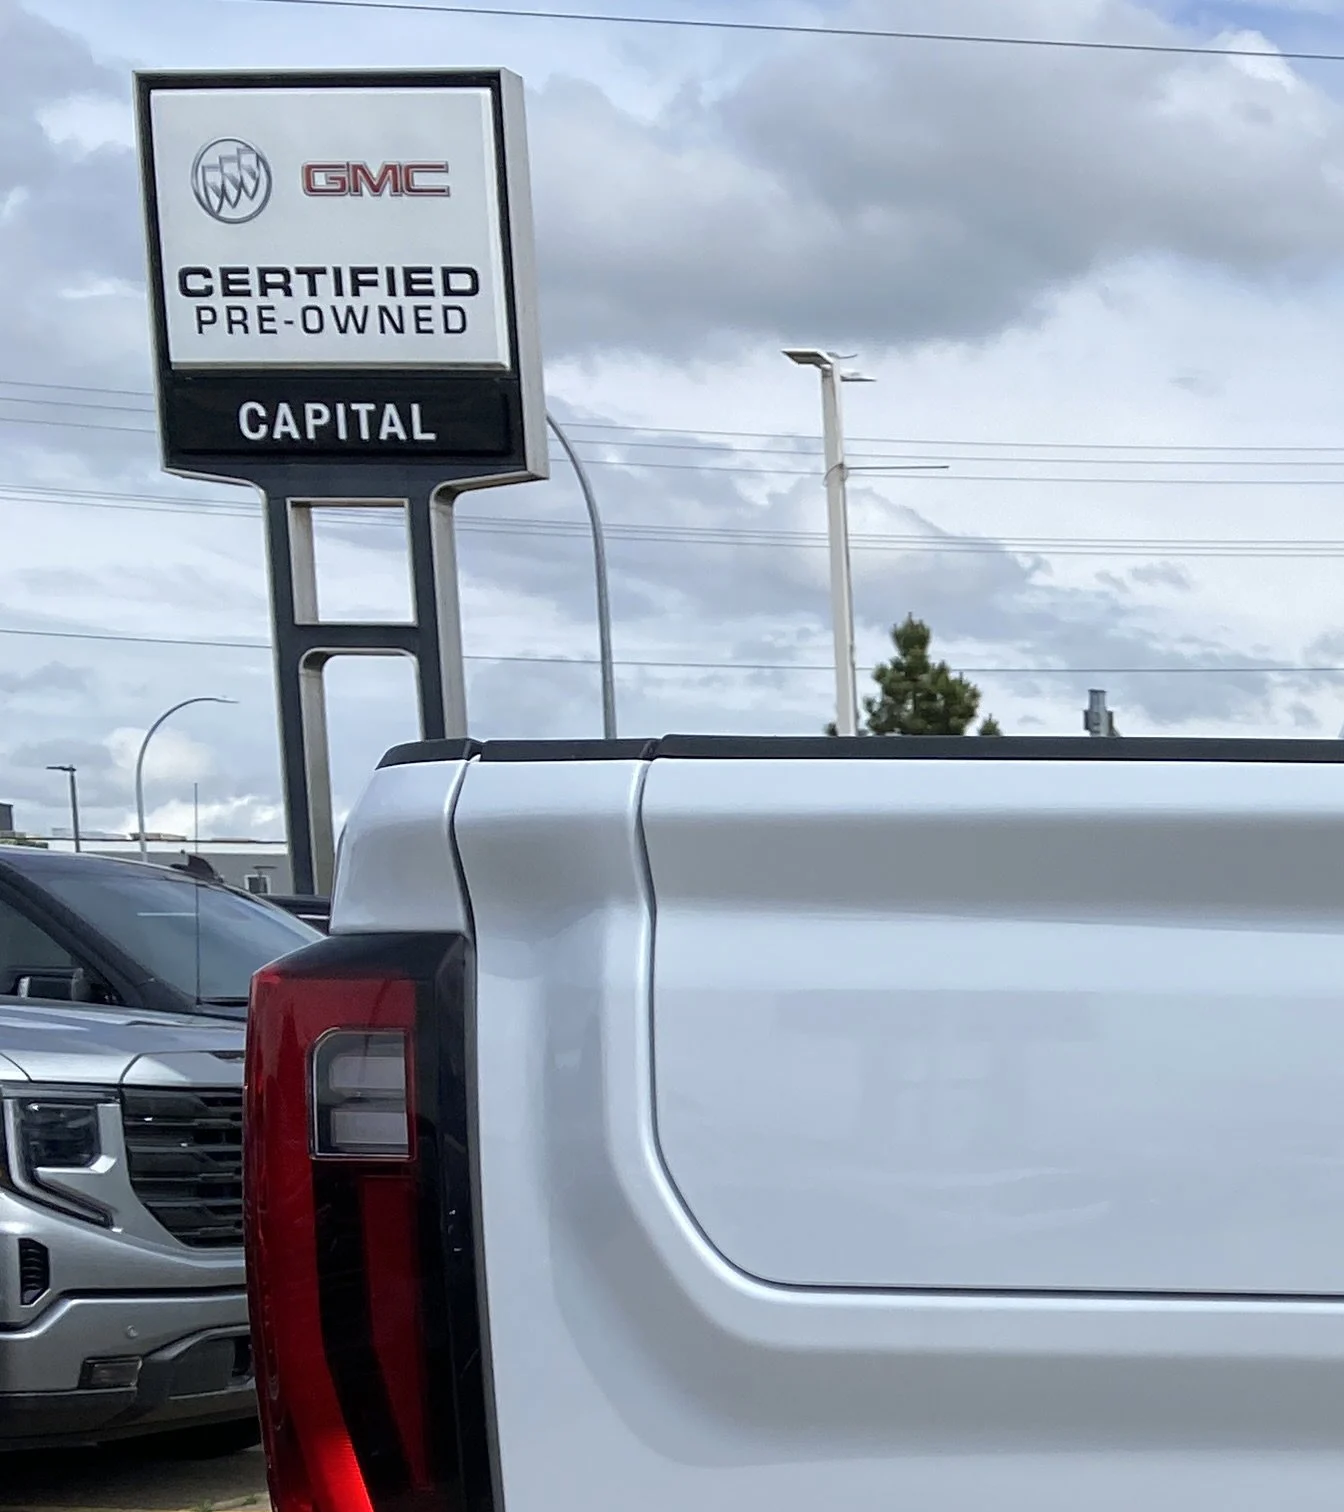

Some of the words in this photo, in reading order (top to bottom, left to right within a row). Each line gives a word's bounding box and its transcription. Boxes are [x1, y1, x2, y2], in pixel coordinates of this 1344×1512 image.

[301, 160, 451, 198] GMC
[177, 266, 480, 297] CERTIFIED
[196, 305, 468, 335] PRE-OWNED
[239, 401, 437, 442] CAPITAL
